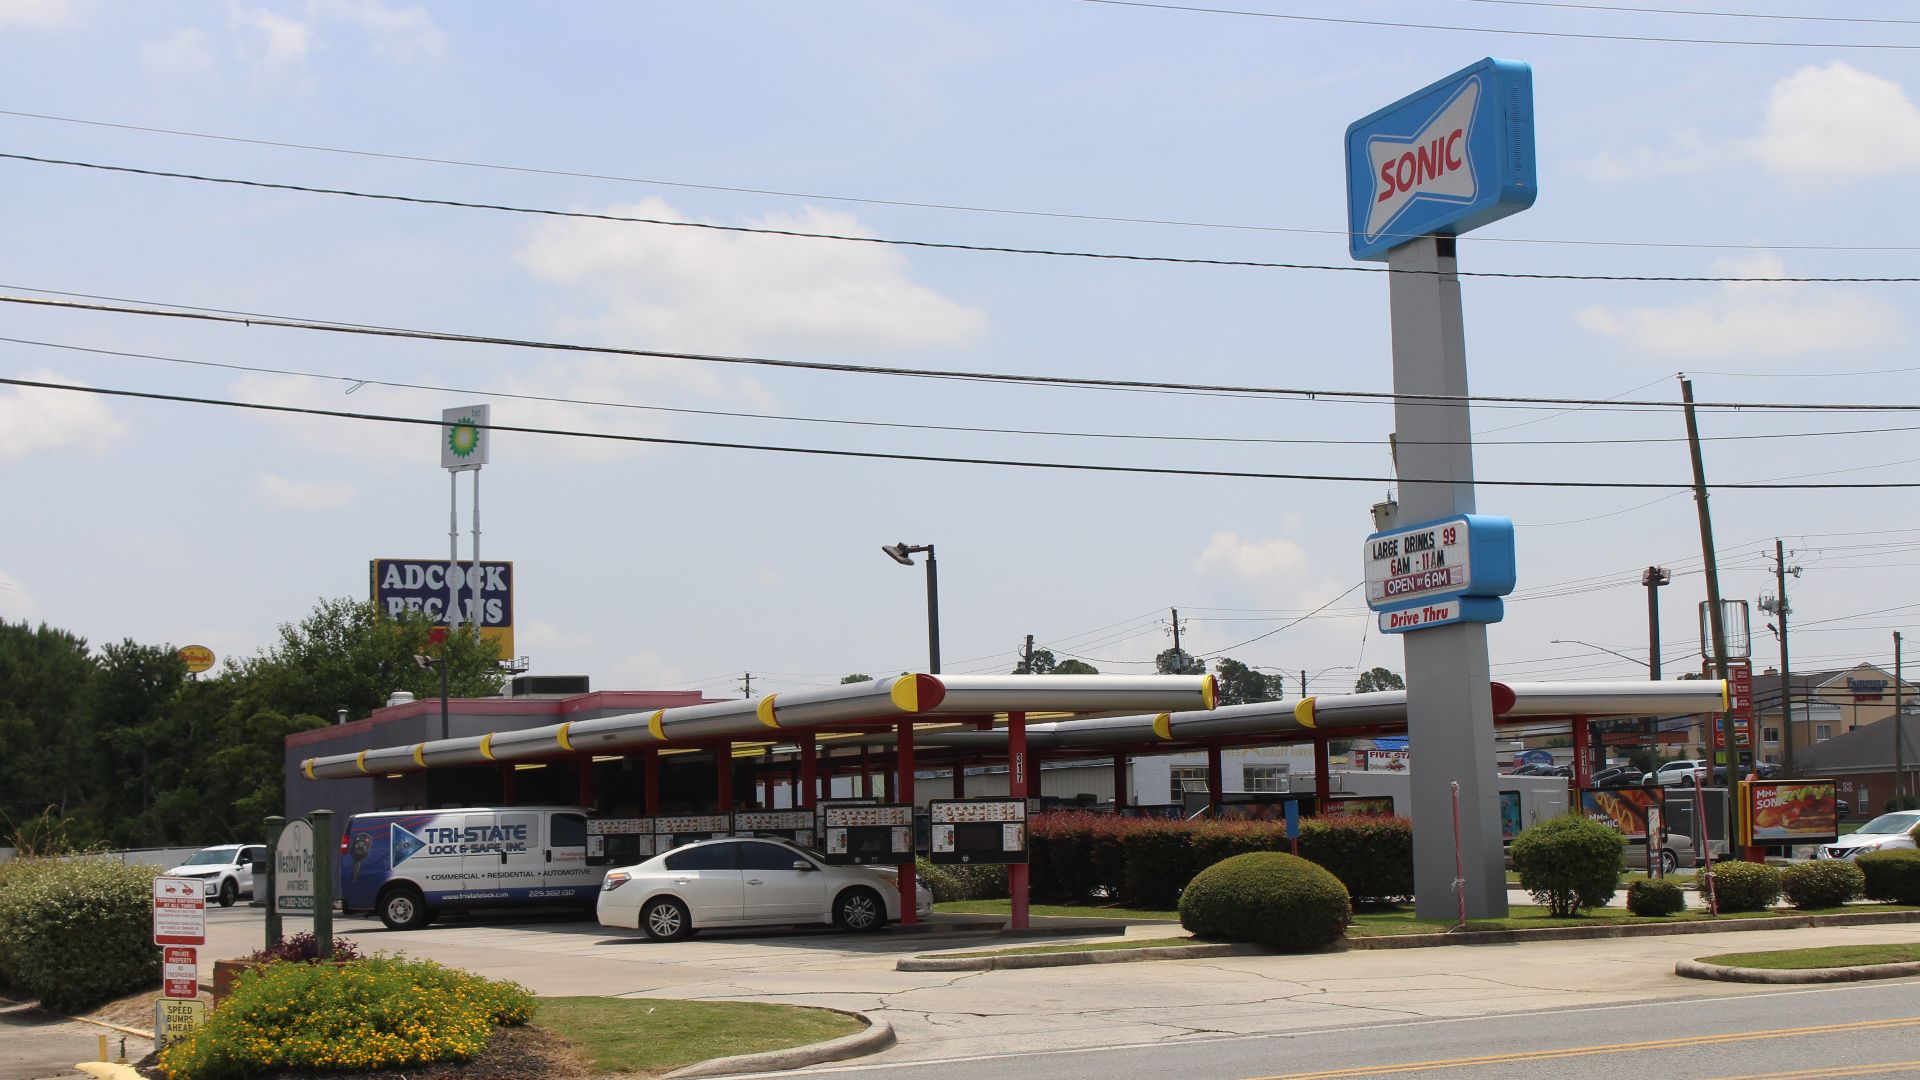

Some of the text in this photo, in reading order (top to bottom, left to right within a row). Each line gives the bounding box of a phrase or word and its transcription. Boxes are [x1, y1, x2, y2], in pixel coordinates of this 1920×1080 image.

[1378, 128, 1463, 203] SONIC
[1373, 526, 1456, 560] LARGE DRINKS 99
[1391, 558, 1410, 575] 6AM
[1422, 550, 1444, 570] 11AM
[382, 563, 507, 591] ADCOCK
[1387, 577, 1415, 594] OPEN
[387, 596, 503, 624] PECANS
[1391, 606, 1448, 628] Drive Thru
[425, 824, 527, 844] TRI-STATE
[428, 845, 457, 855] LOCK
[459, 845, 468, 853] &
[277, 849, 314, 878] Westbury Plac
[431, 868, 591, 881] COMMERCIAL RESIDENTIAL AUTOMOTIVE
[167, 1006, 193, 1015] SPEED
[167, 1015, 193, 1023] BUMPS
